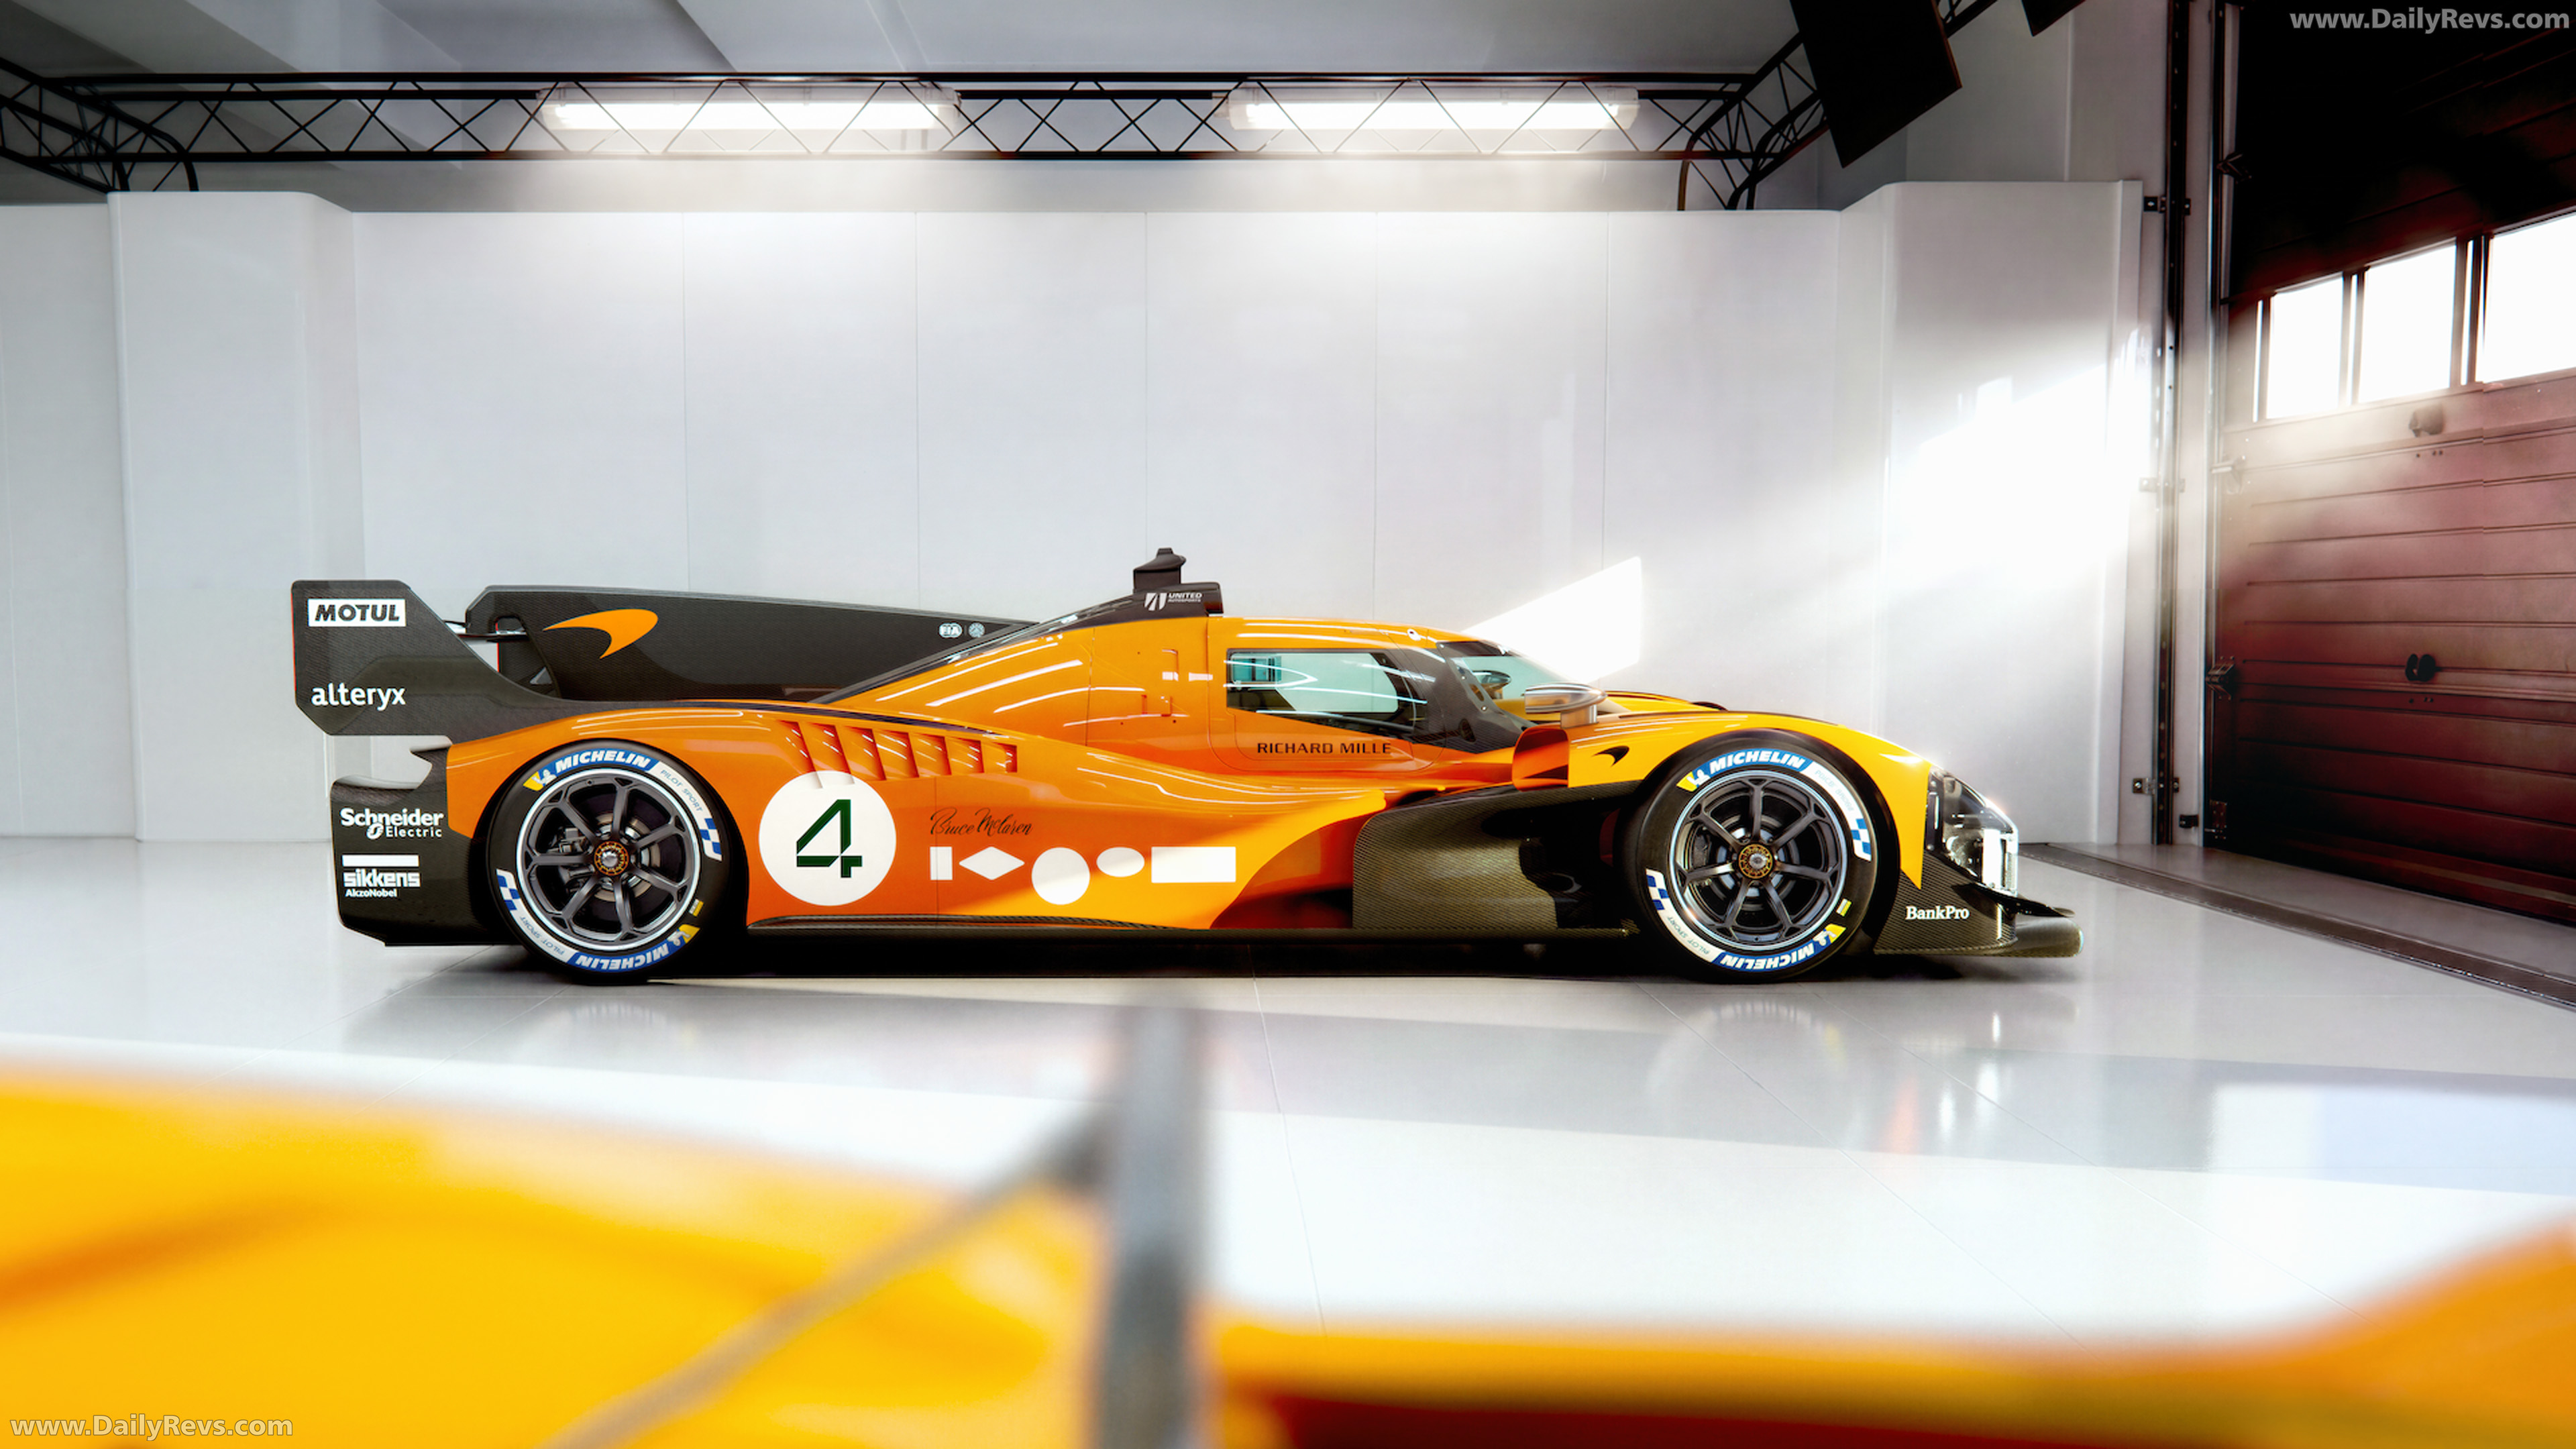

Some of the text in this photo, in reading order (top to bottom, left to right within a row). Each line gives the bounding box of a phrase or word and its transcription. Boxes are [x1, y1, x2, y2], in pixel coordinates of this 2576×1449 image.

[315, 604, 400, 621] MOTUL
[311, 682, 406, 711] alteryx
[1257, 743, 1391, 753] RICHARD MILLE
[555, 750, 651, 773] MICHELIN
[1709, 750, 1805, 774] MICHELIN
[660, 769, 704, 812] PILOT SPORT
[339, 808, 444, 826] Schneider
[930, 807, 974, 835] Bruce
[385, 826, 443, 837] Electric
[796, 799, 862, 878] 4
[343, 868, 421, 888] sikkens
[345, 888, 398, 898] AkzoNobel
[1905, 905, 1970, 920] BankPro
[541, 939, 565, 955] PILOT
[576, 942, 669, 970] MICHELIN
[1687, 939, 1710, 955] PILOT
[1720, 943, 1815, 970] MICHELIN
